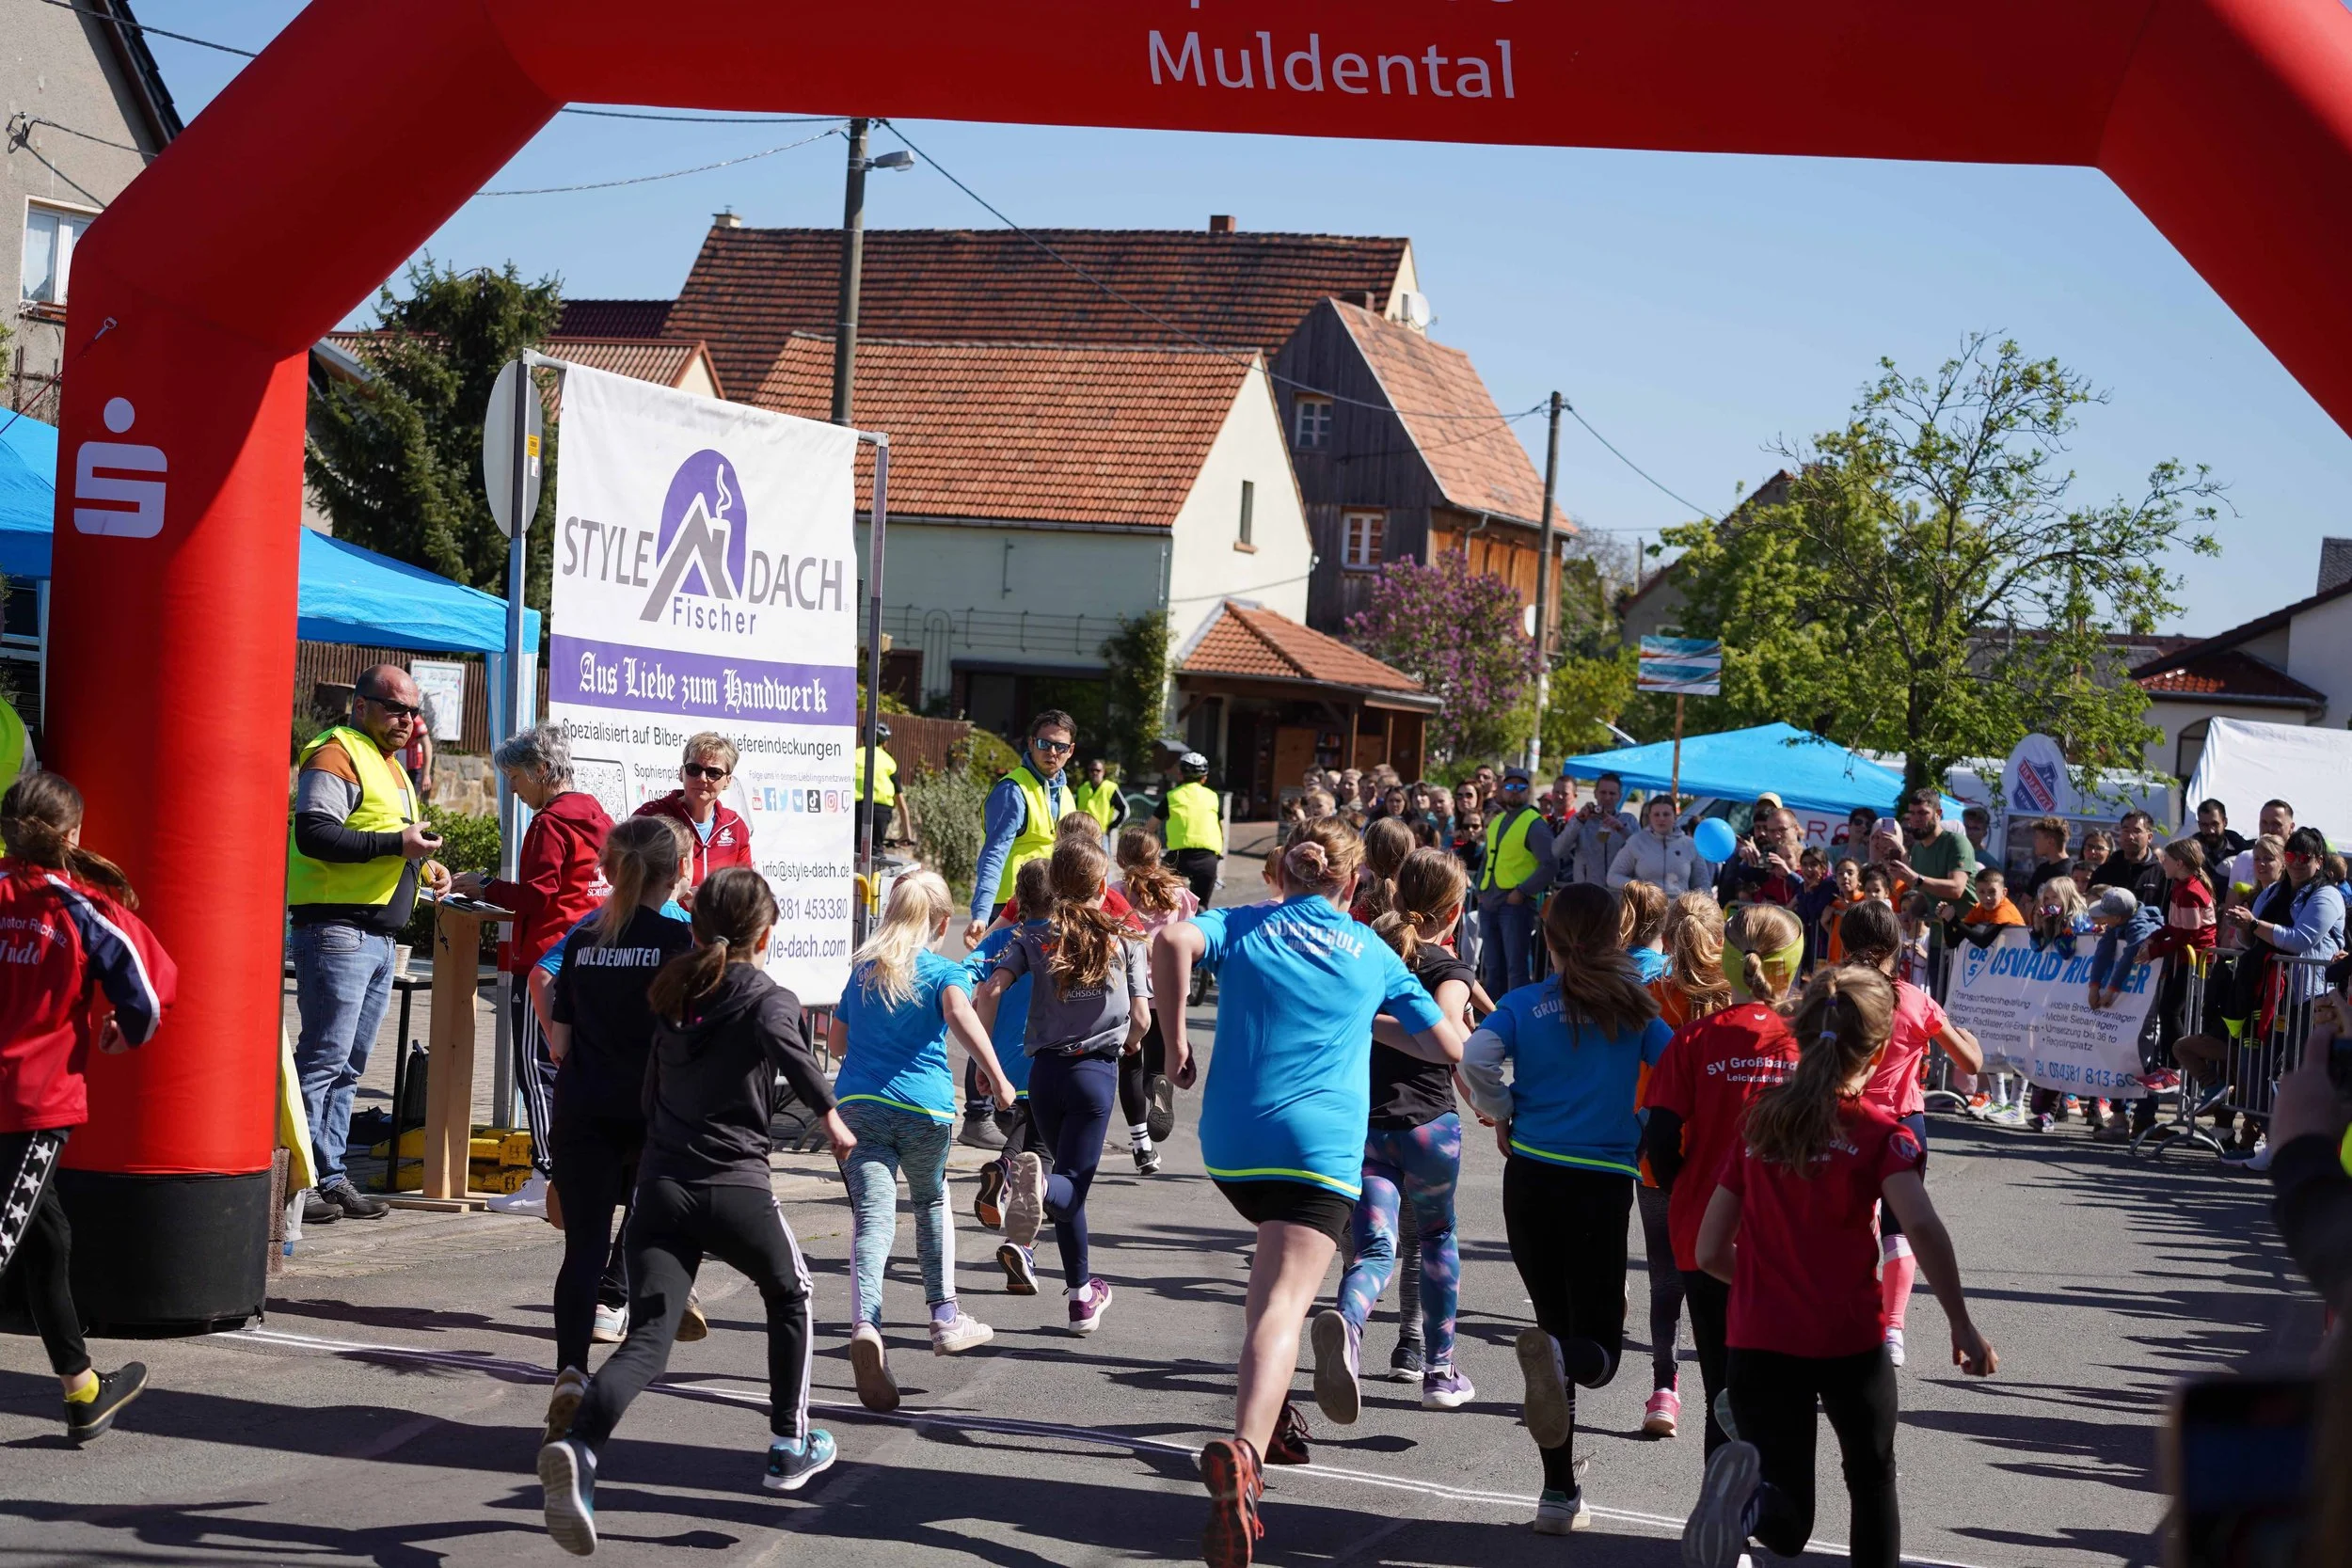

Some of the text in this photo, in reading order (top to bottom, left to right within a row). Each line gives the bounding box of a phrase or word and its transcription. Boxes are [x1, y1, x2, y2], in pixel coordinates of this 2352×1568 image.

[1149, 29, 1515, 99] Muldental
[562, 515, 843, 612] STYLE DACH
[673, 595, 757, 636] Fischer
[579, 651, 829, 714] Aus Liebe zum Handwerk
[563, 718, 842, 760] Spezialisiert auf Biber- iefereindeckungen
[634, 763, 680, 783] Sophienpla
[762, 861, 850, 881] info@style-dach.de
[779, 898, 848, 920] 381 453380
[766, 933, 846, 965] yle-dach.com
[1990, 946, 2152, 994] OSWALD RICER
[2108, 1035, 2118, 1044] to
[1707, 1056, 1800, 1076] SV Großbard
[1726, 1073, 1785, 1084] Leichtathlet
